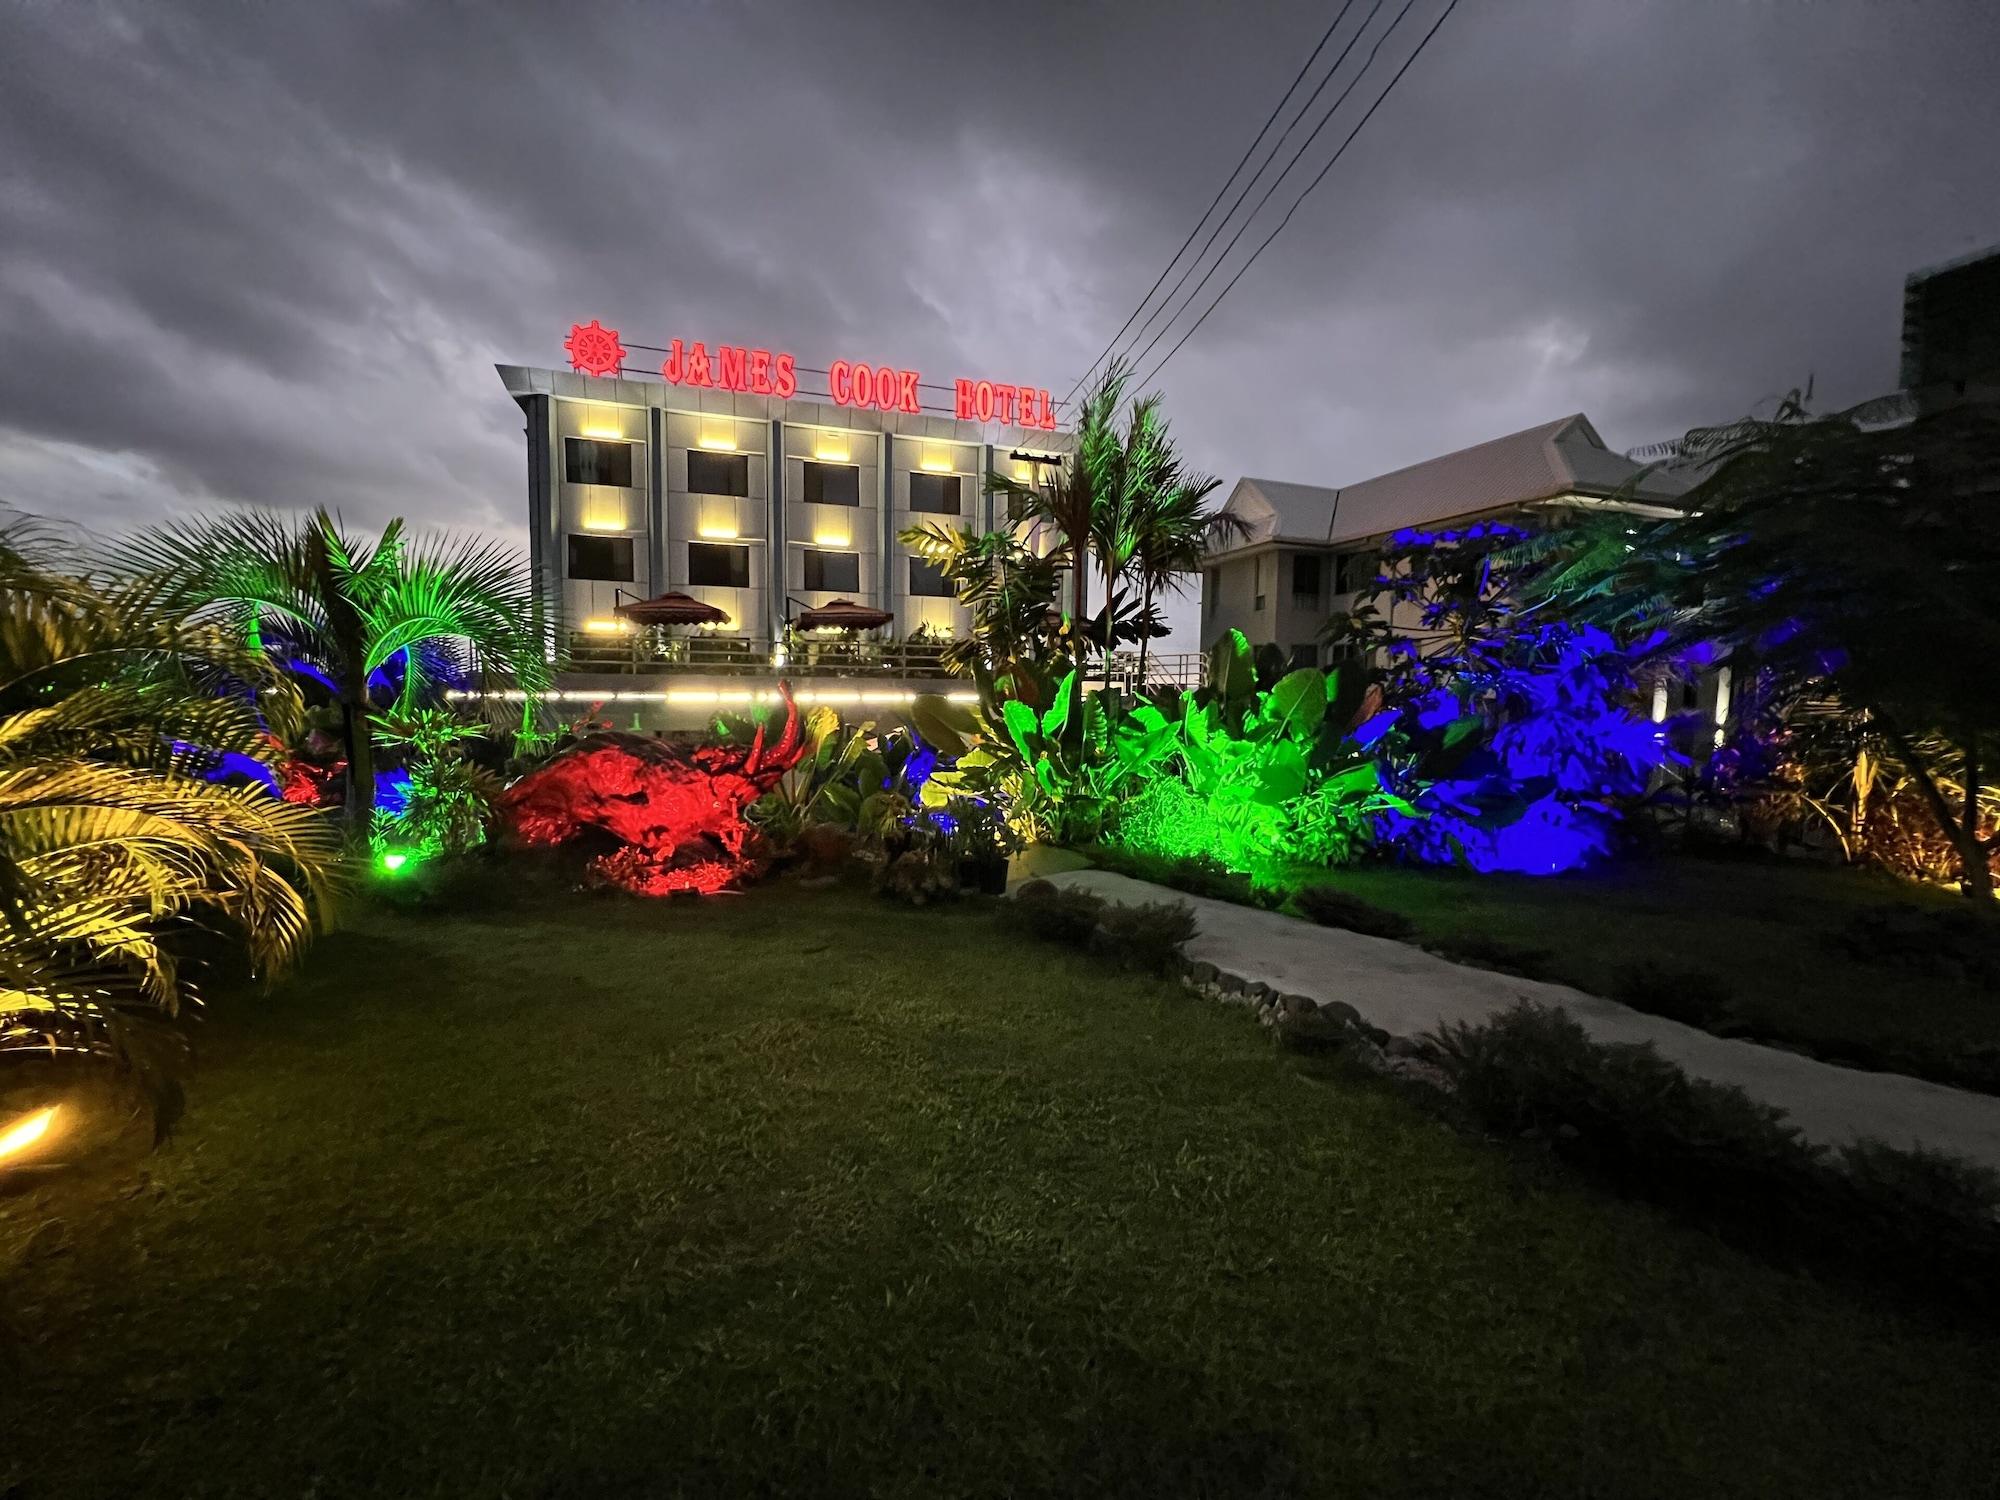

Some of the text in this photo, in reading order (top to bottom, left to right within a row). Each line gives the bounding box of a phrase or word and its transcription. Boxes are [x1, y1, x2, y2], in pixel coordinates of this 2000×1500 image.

[664, 339, 1056, 429] JAMES COOK HOTEL
